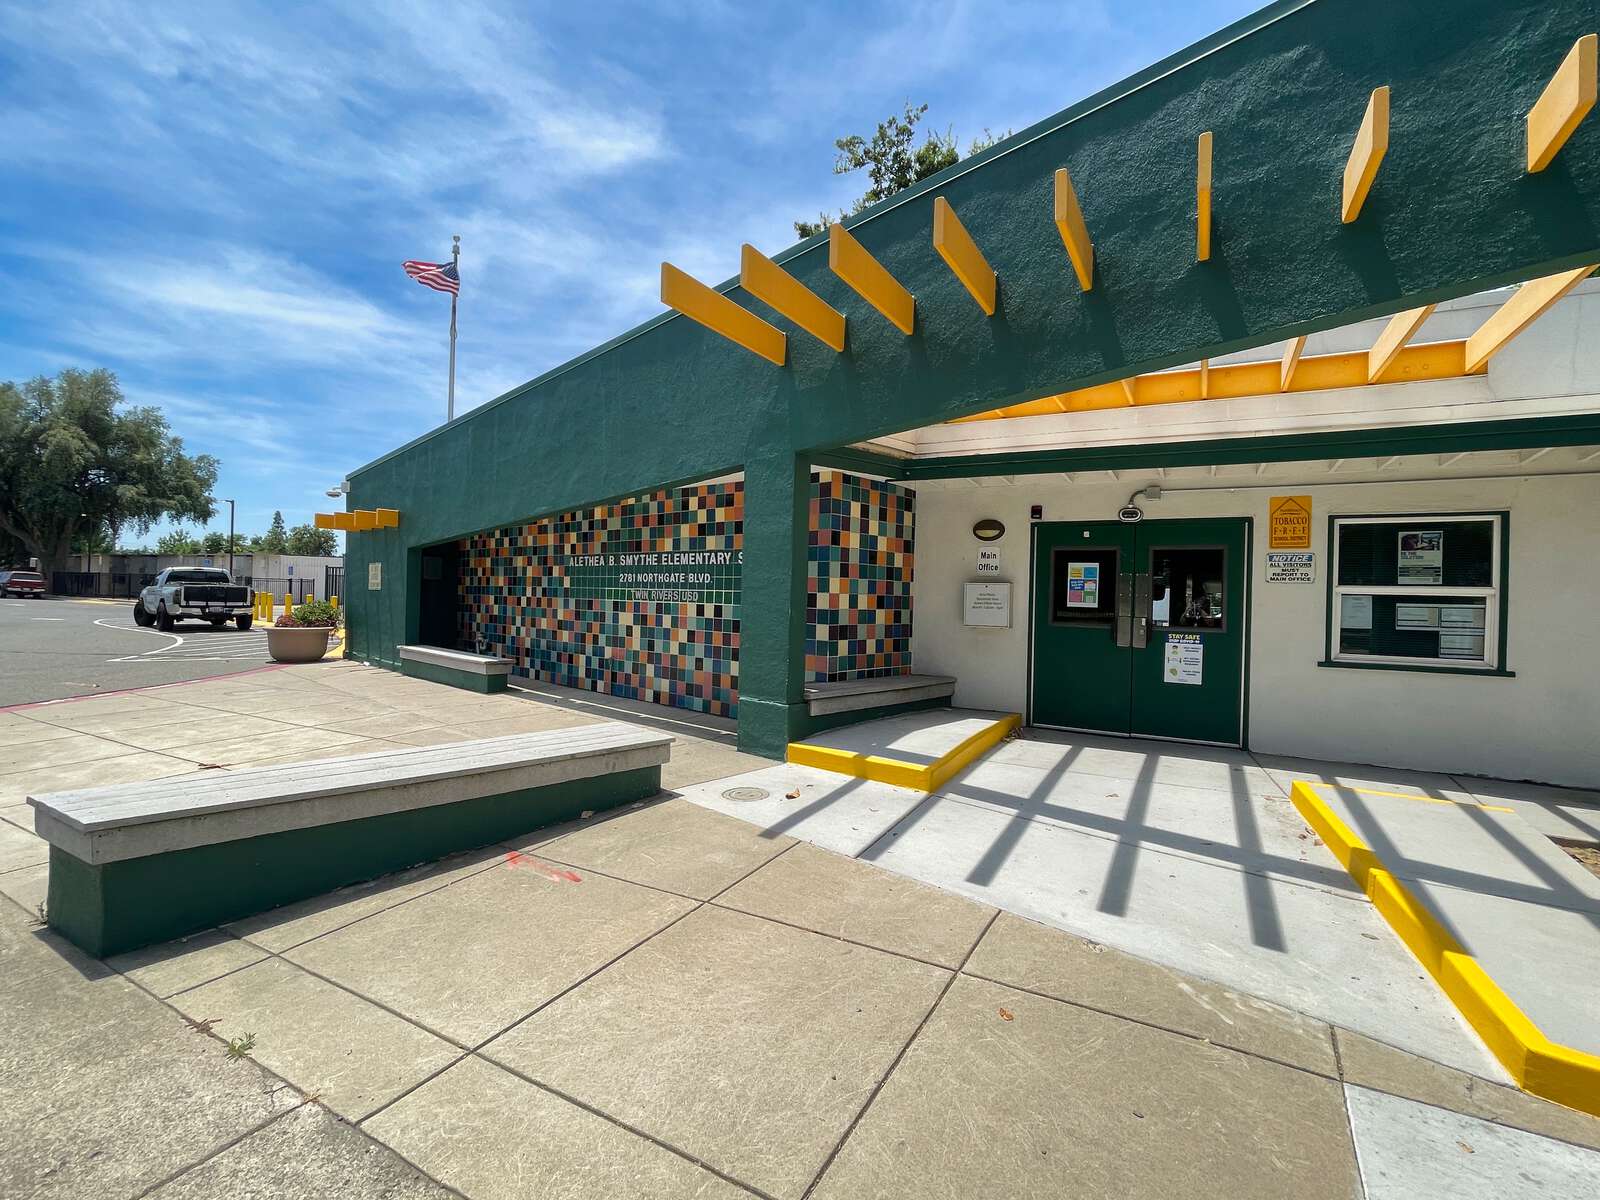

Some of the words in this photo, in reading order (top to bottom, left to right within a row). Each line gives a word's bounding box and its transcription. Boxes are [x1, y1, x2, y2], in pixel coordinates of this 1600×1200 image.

[569, 555, 605, 567] ALETHEA
[608, 555, 617, 567] B.
[620, 554, 658, 566] SMYTHE
[661, 552, 731, 565] ELEMENTARY
[980, 552, 997, 560] Main
[978, 563, 999, 571] Office
[620, 573, 636, 583] 2781
[637, 573, 685, 583] NORTHGATE
[688, 573, 713, 583] BLVD.
[631, 590, 648, 600] TWIN
[651, 590, 679, 600] RIVERS
[682, 591, 699, 601] USD
